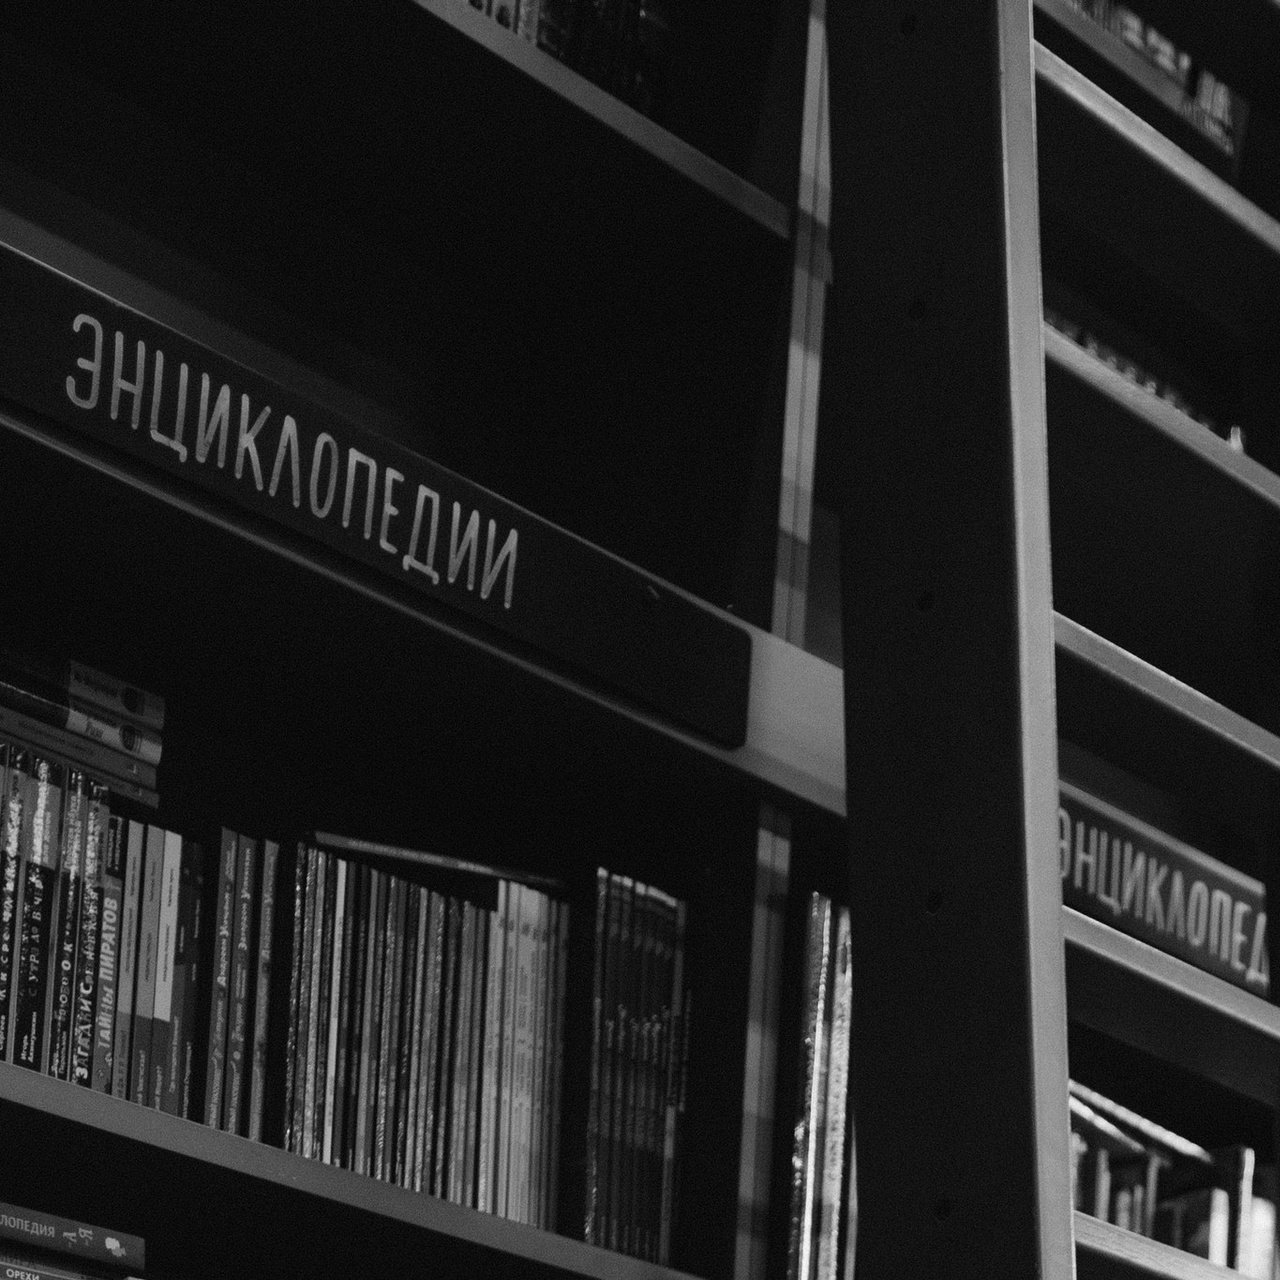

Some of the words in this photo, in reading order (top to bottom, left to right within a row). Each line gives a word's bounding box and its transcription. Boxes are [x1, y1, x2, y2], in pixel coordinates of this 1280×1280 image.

[64, 311, 520, 609] ЭНЦИКЛОПЕДИИ
[99, 897, 118, 982] ПИРАТОВ
[97, 986, 113, 1050] ТАЙНЫ
